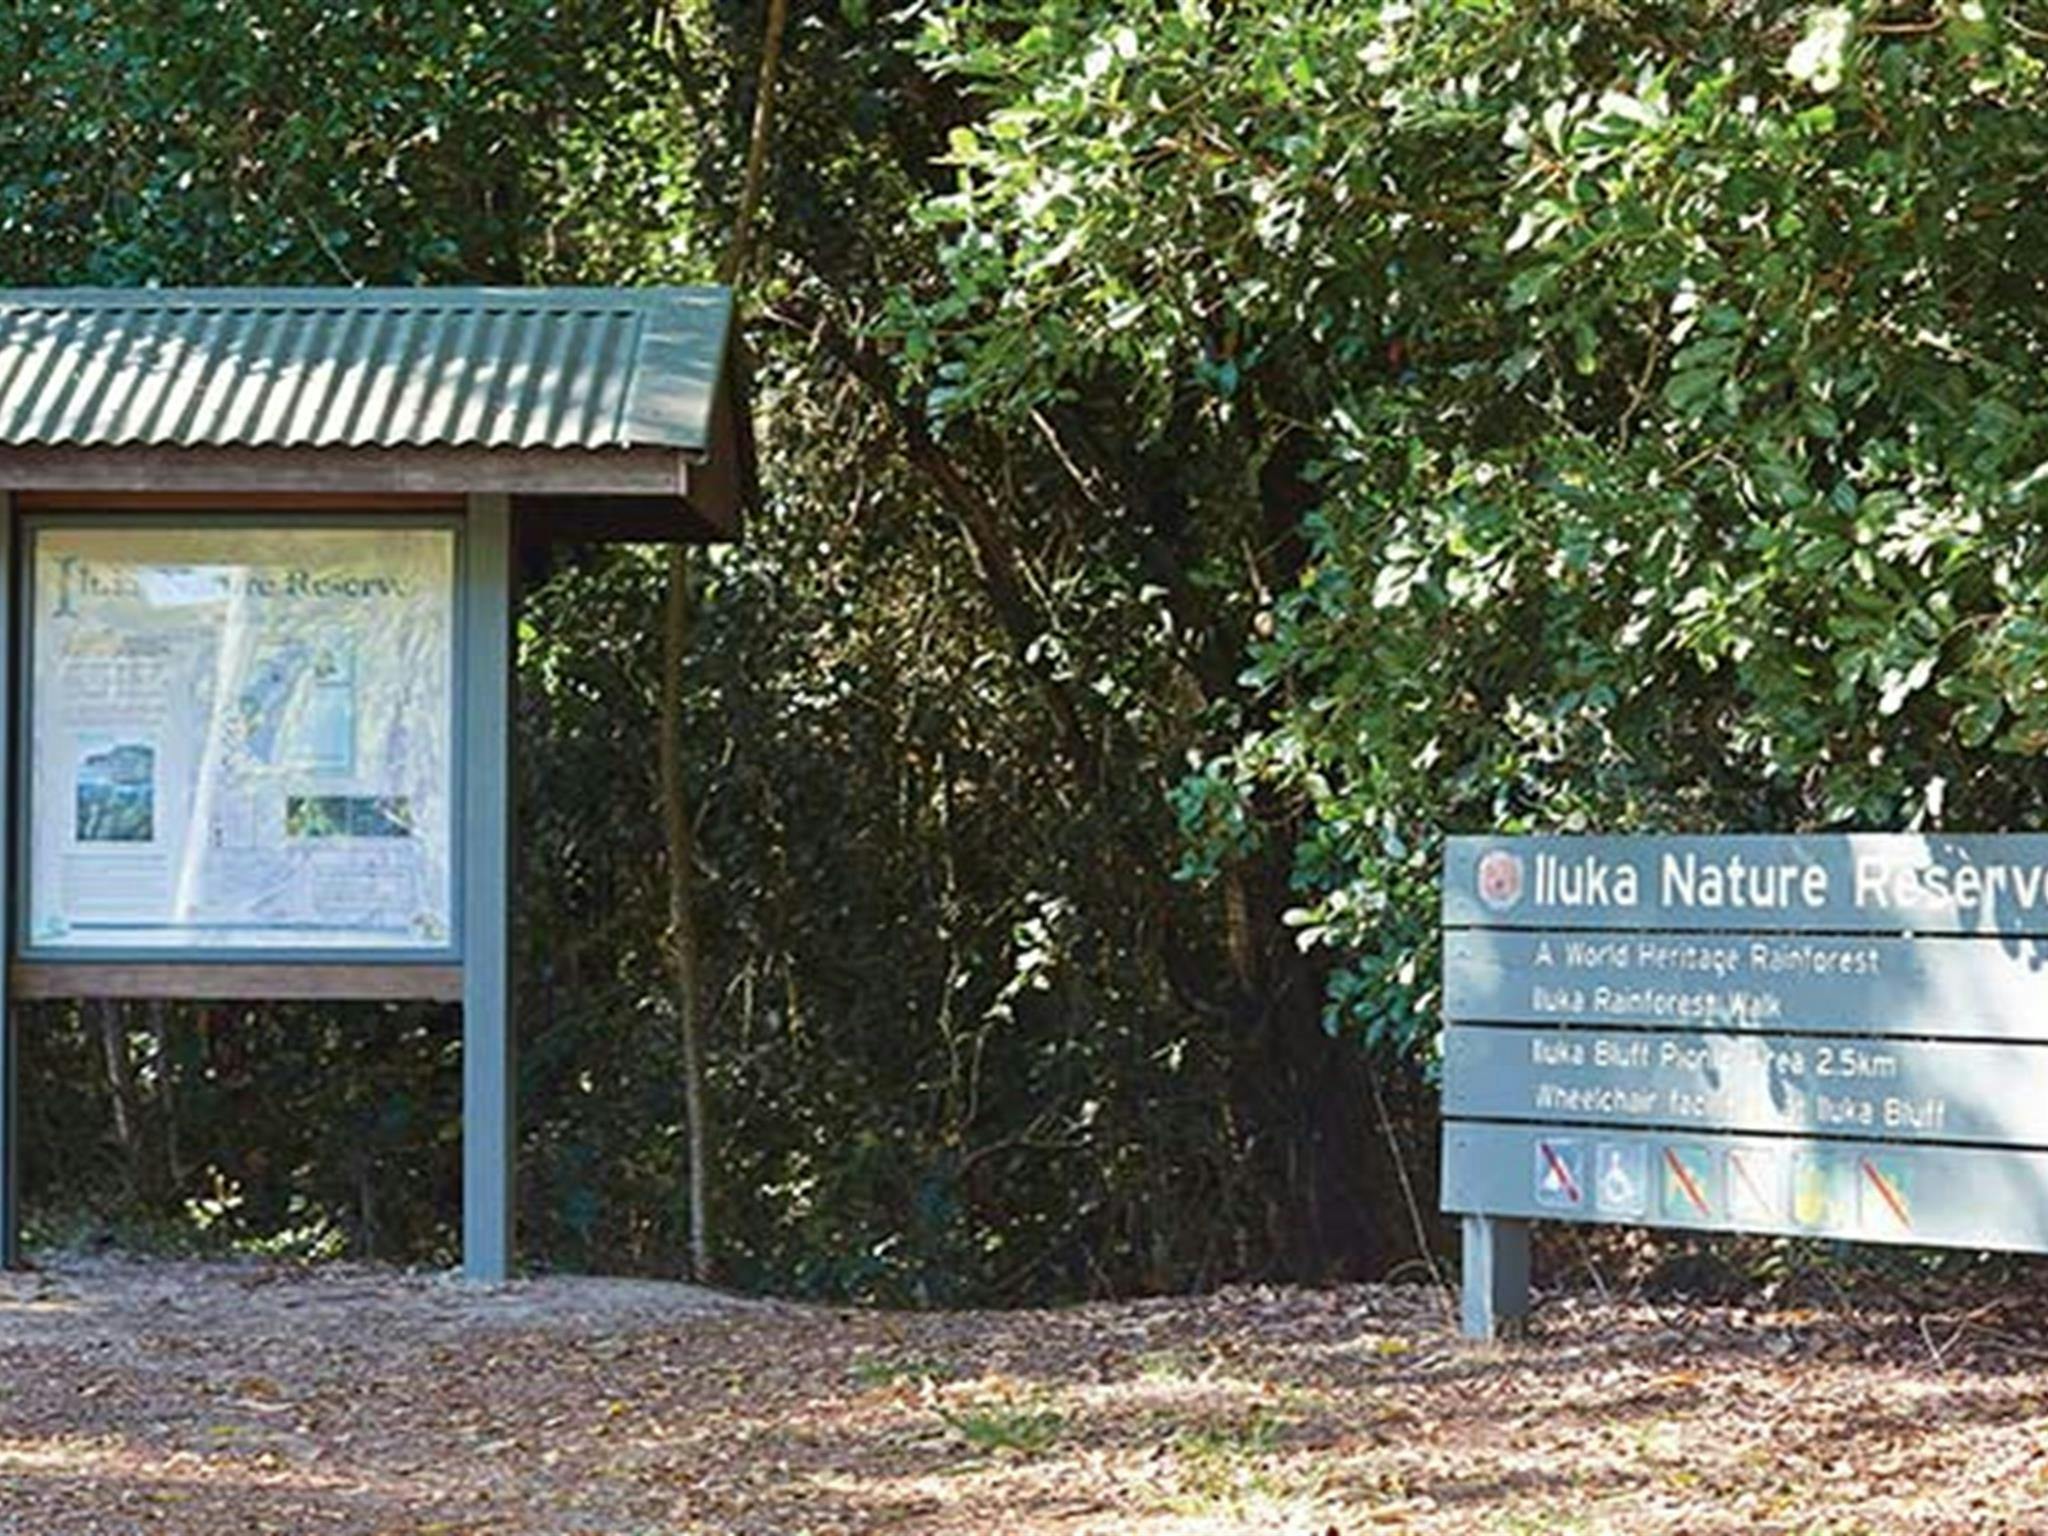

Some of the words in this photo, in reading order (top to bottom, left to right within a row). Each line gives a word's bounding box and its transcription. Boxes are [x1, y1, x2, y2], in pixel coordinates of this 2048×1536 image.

[1534, 853, 1638, 906] Iluka
[1662, 853, 1828, 908] Nature
[1533, 940, 1554, 967] A
[1564, 941, 1629, 968] World
[1638, 942, 1740, 979] Heritage
[1750, 943, 1880, 974] Rainforest
[1532, 984, 1585, 1013] Iluka
[1594, 985, 1717, 1017] Rainforest
[1727, 990, 1782, 1019] Walk
[1531, 1038, 1585, 1065] Iluka
[1594, 1039, 1650, 1068] Bluff
[1659, 1040, 1732, 1071] Picn
[1745, 1045, 1805, 1076] rea
[1815, 1047, 1898, 1078] 2.5km
[1534, 1083, 1657, 1113] Wheelchair
[1816, 1095, 1873, 1126] Iluka
[1882, 1097, 1945, 1130] Bluff
